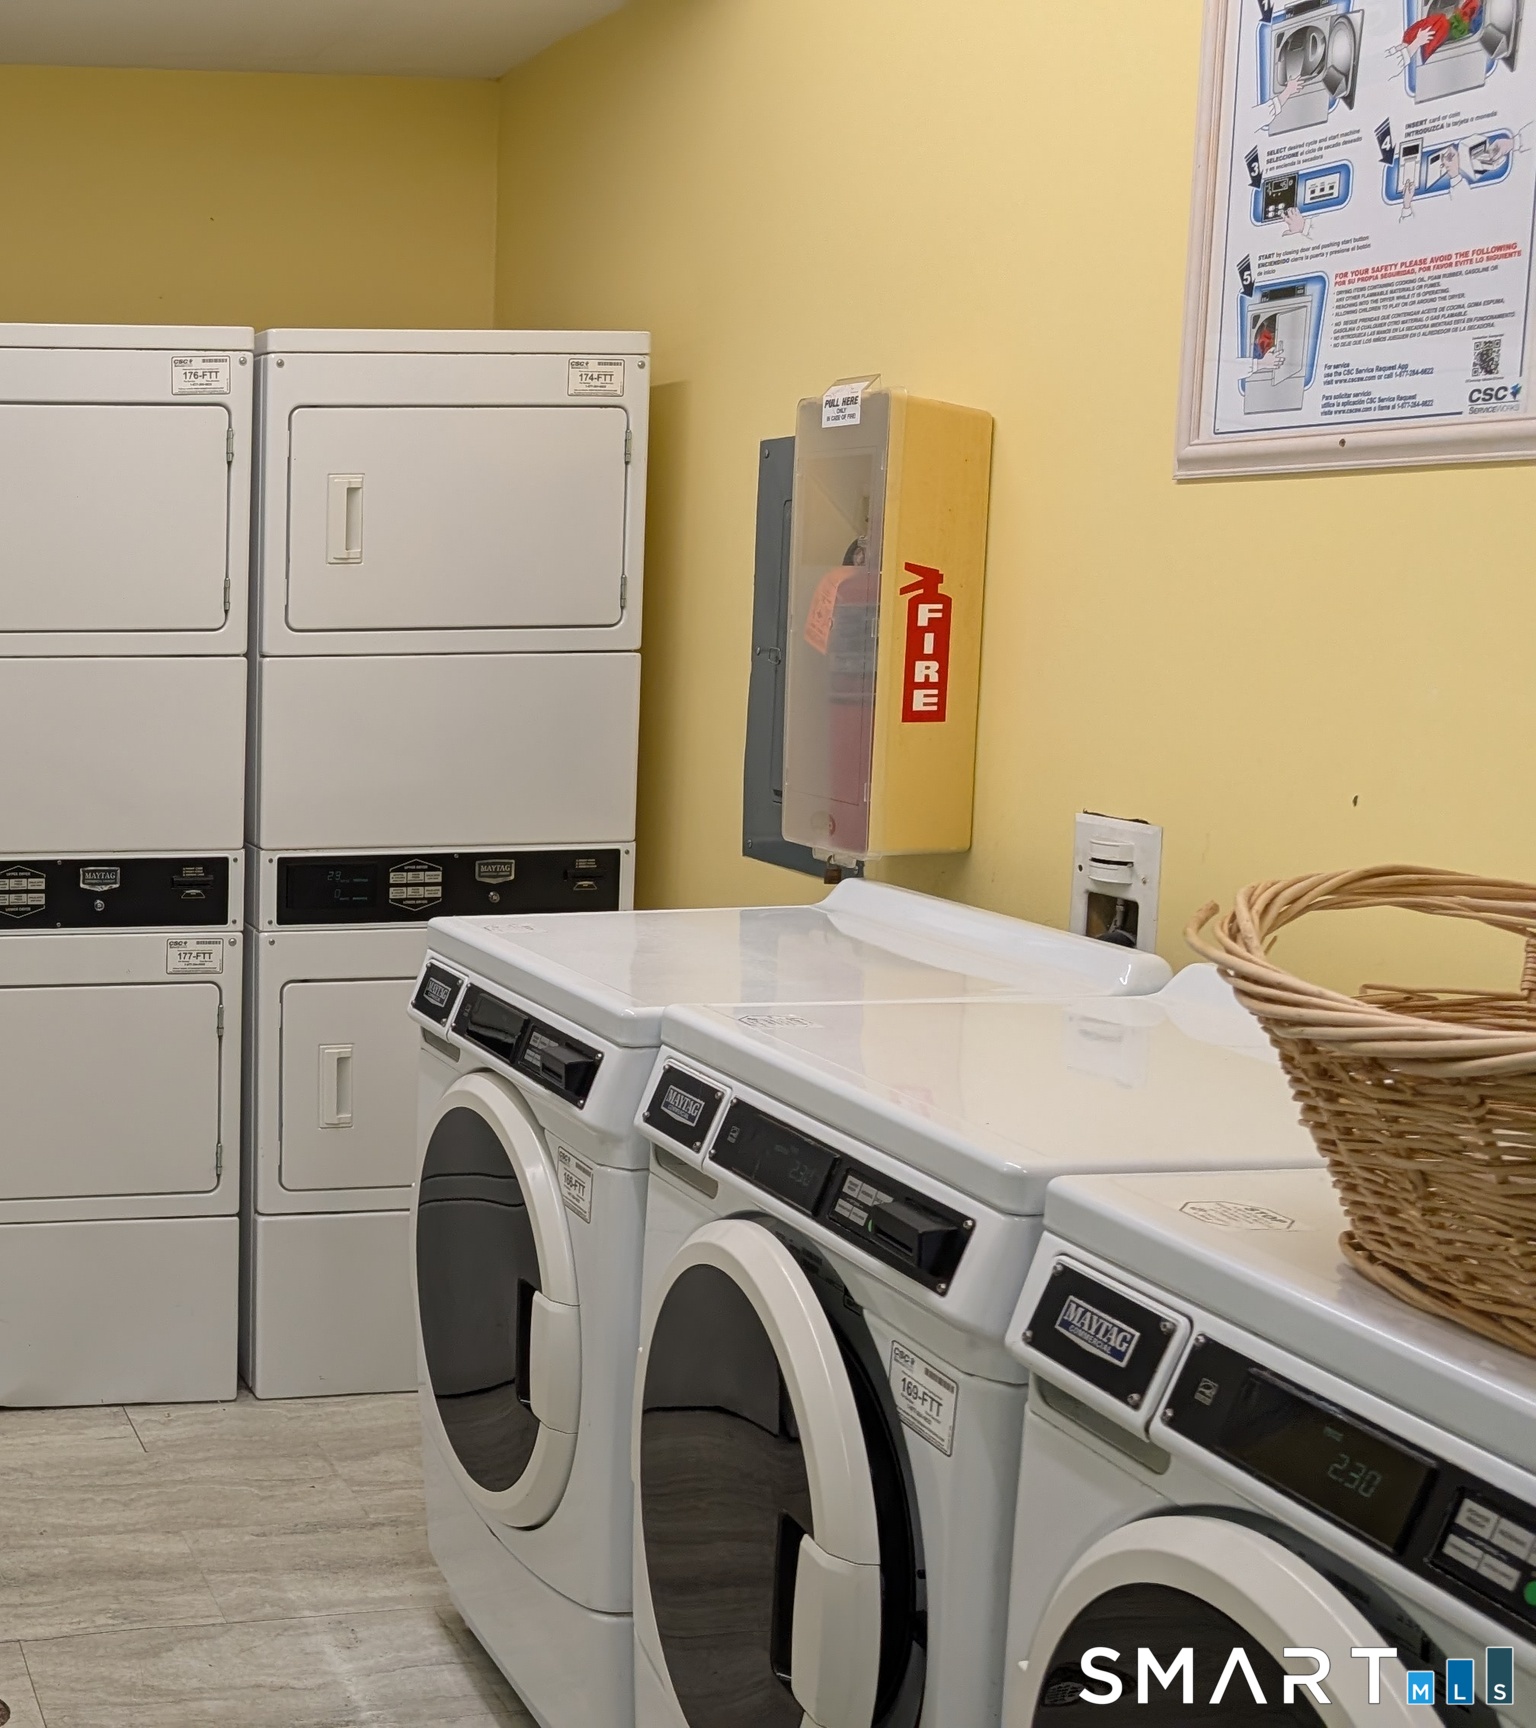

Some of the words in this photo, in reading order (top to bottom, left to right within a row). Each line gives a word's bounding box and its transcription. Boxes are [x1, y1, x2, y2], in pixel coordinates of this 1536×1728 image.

[1382, 135, 1392, 150] 4
[1266, 146, 1286, 156] SELECT
[1266, 151, 1298, 164] SELECCIONE
[1251, 162, 1261, 177] 3
[1334, 271, 1348, 279] FOR
[1350, 268, 1368, 276] YOUR
[1371, 263, 1398, 273] SAFETY
[1400, 258, 1427, 268] PLEASE
[1429, 253, 1452, 263] AVOID
[1454, 250, 1469, 259] THE
[1471, 242, 1517, 256] FOLLOWING
[1356, 274, 1378, 282] PROPIA
[1432, 261, 1452, 270] FAVOR
[1454, 258, 1473, 266] EVITE
[1485, 250, 1521, 261] SIGUIENTE
[1243, 270, 1252, 285] 5
[183, 371, 220, 379] 176-FTT
[1355, 366, 1373, 374] Service
[1375, 364, 1396, 372] Request
[1397, 362, 1408, 370] App
[579, 373, 614, 382] 174-FTT
[824, 398, 840, 408] PULL
[842, 396, 859, 406] HERE
[1396, 393, 1416, 401] Request
[1468, 386, 1508, 403] CSC
[912, 604, 943, 711] FIRE
[480, 864, 510, 872] MAYTAG
[177, 952, 213, 960] 177-FTT
[666, 1089, 700, 1116] MAYTAG
[1064, 1302, 1131, 1352] MAYTAG
[1069, 1325, 1112, 1354] COMMERCIAL
[894, 1347, 910, 1363] CSC
[901, 1377, 943, 1417] 169-FTT
